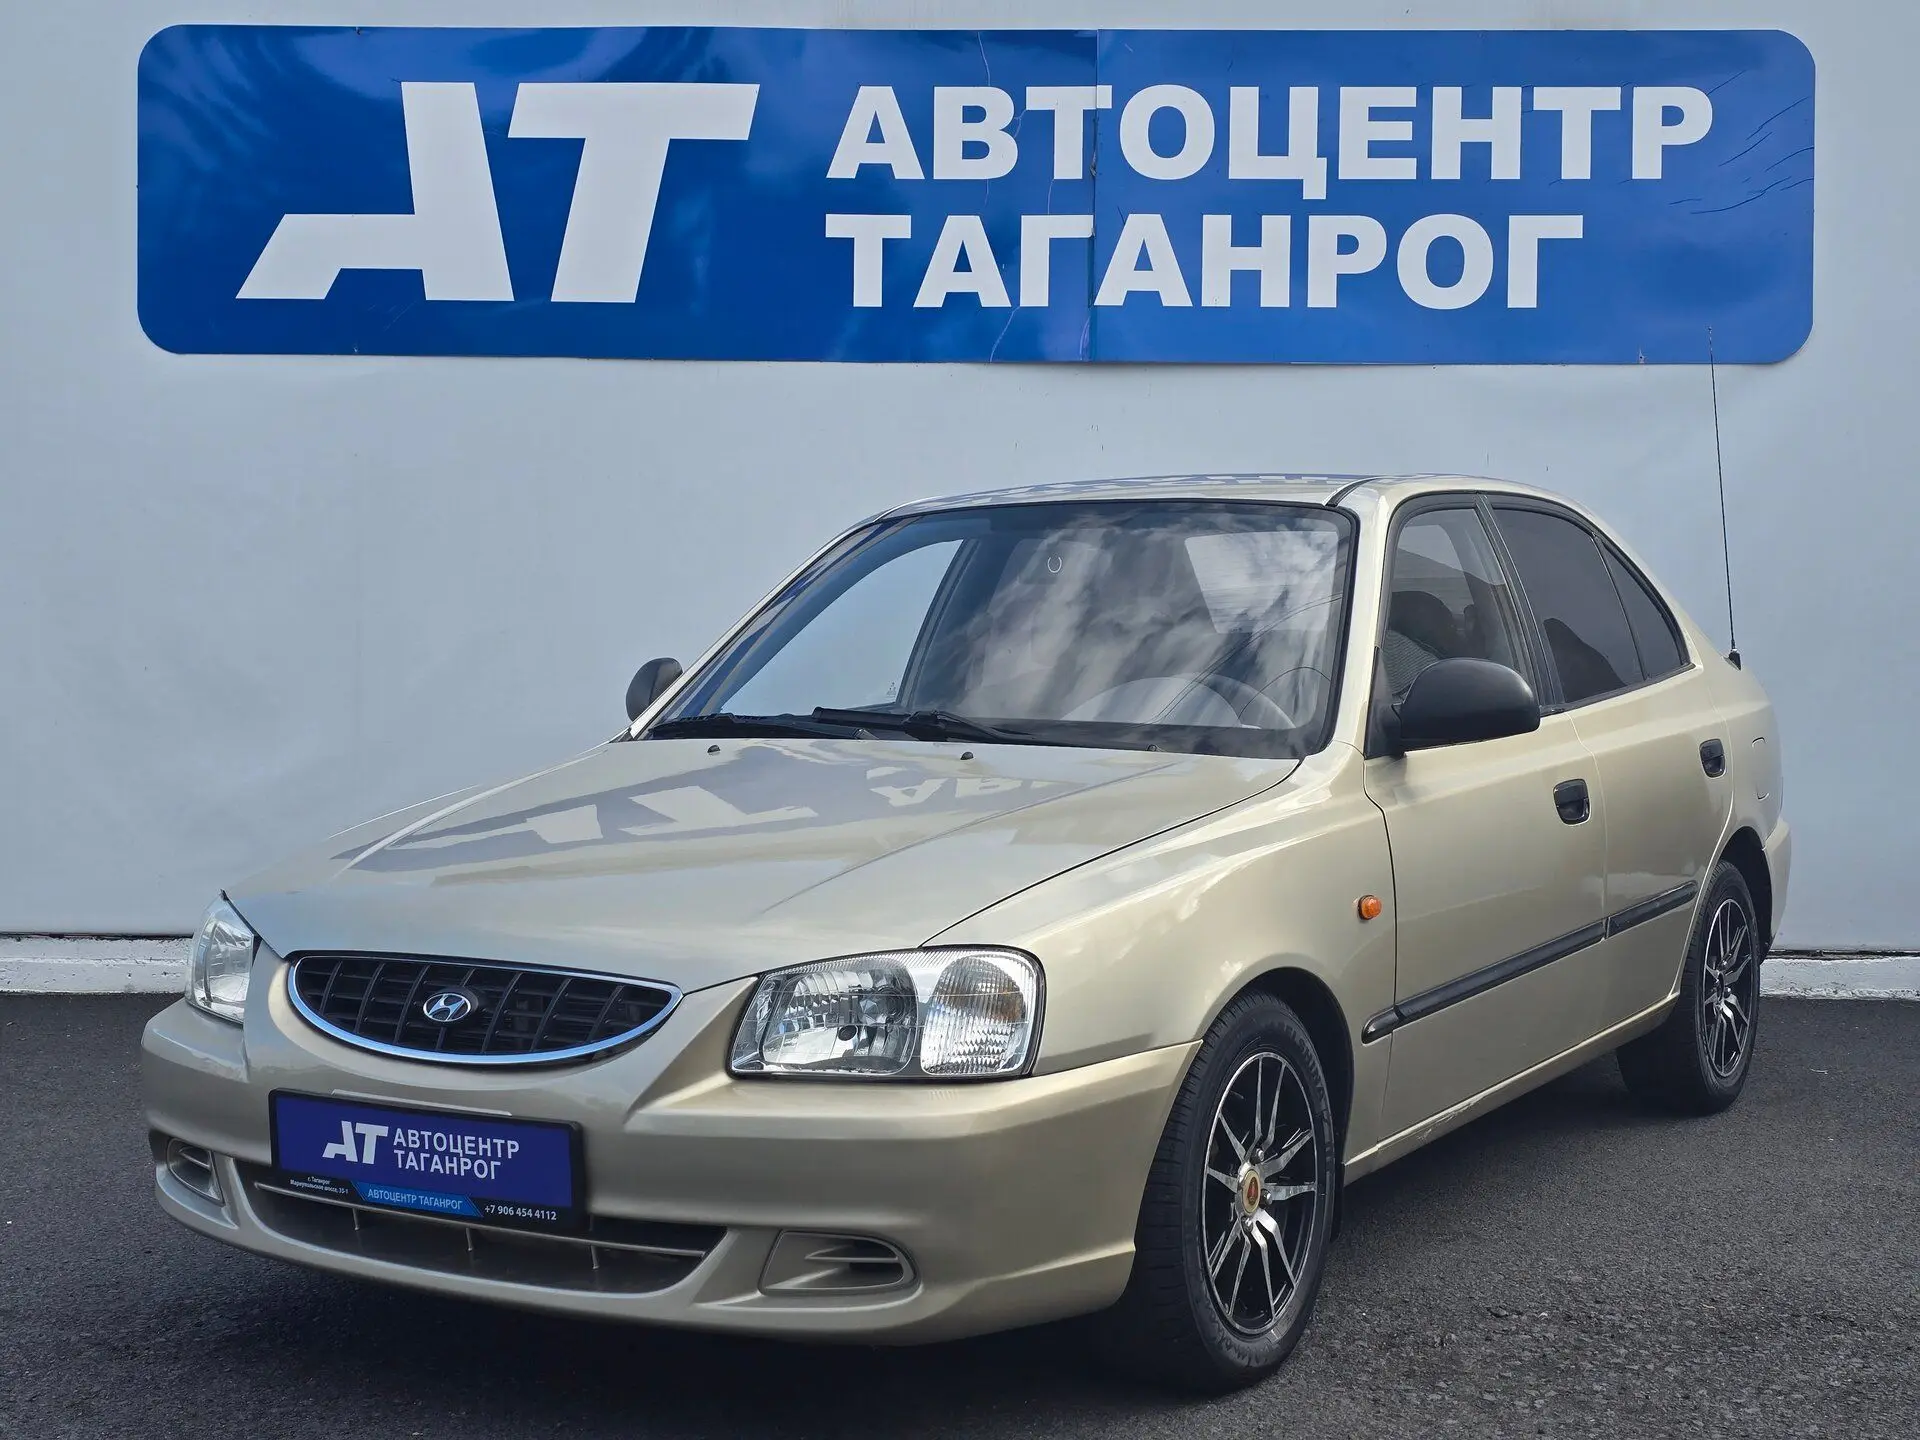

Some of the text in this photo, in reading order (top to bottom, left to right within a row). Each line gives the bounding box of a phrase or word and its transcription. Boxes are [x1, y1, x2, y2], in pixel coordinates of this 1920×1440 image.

[826, 85, 1713, 200] АВТОЦЕНТР
[236, 82, 760, 302] АТ
[825, 213, 1584, 308] ТАГАНРОГ
[322, 1120, 389, 1165] АТ
[393, 1127, 520, 1159] АВТОЦЕНТР
[393, 1149, 501, 1180] ТАГАНРОГ
[367, 1188, 463, 1210] АВТОЦЕНТР ТАГАНРОГ
[484, 1204, 557, 1221] +7 906 454 4112
